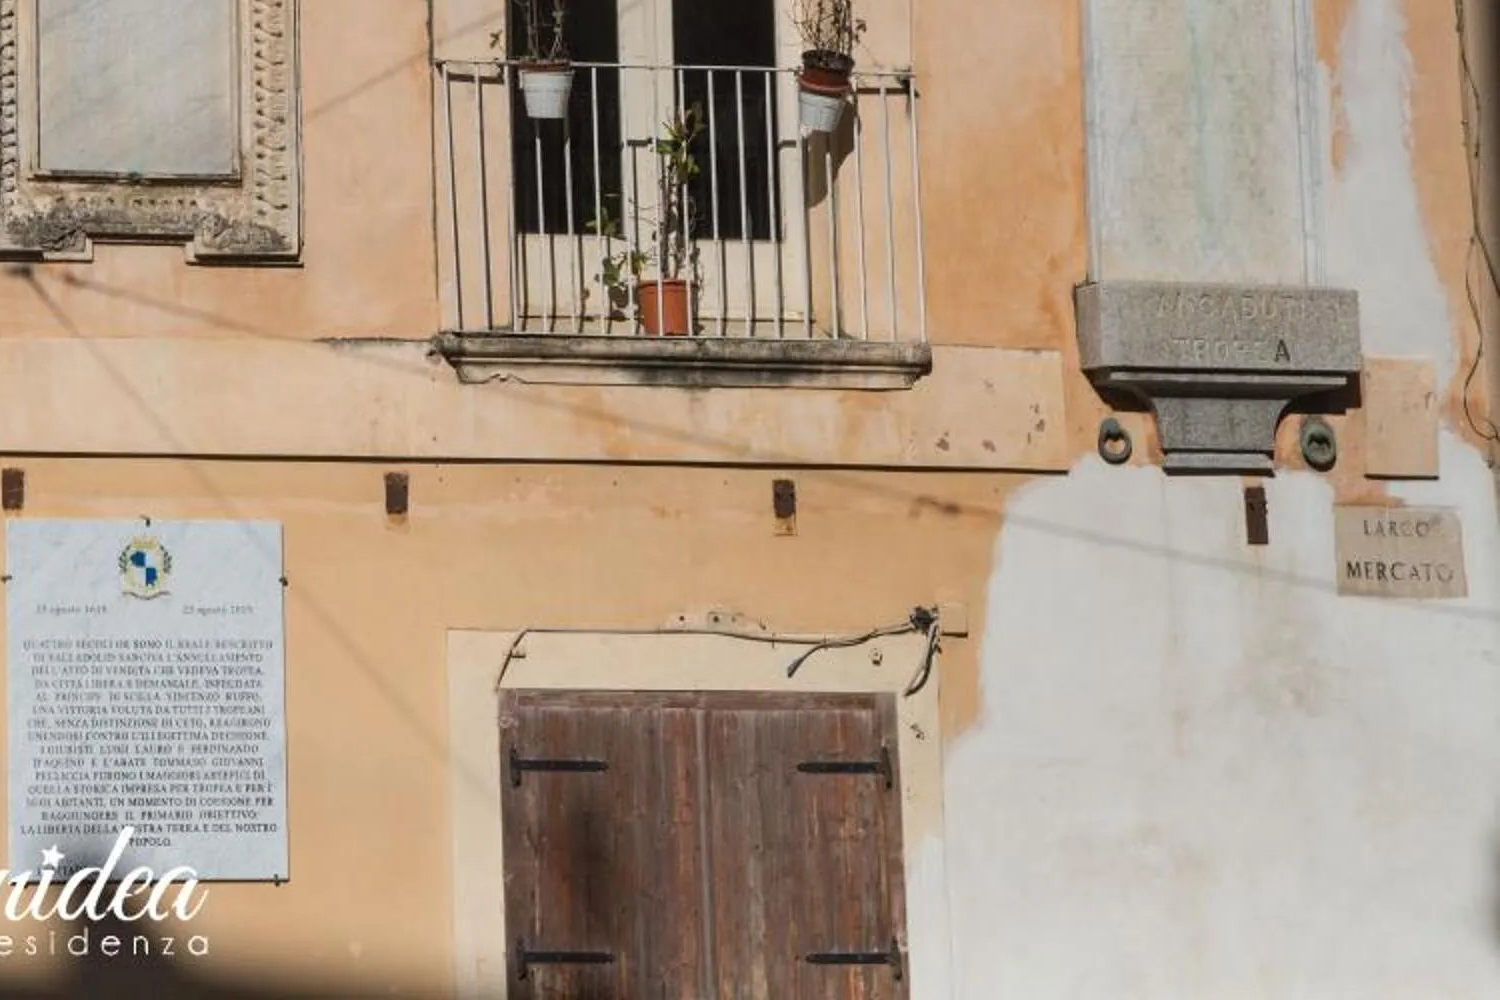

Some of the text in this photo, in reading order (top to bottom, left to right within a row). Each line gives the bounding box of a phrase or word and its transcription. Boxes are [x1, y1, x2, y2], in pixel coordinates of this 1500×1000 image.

[1346, 560, 1454, 582] MERCATO
[132, 639, 163, 650] SONO
[47, 652, 116, 663] VALLADOLID
[105, 665, 152, 676] VENDITA
[154, 665, 175, 676] CHE
[177, 665, 220, 676] VEDEVA
[167, 691, 220, 702] VINCENZO
[57, 705, 108, 715] VITTORIA
[110, 705, 153, 715] VOLUTA
[55, 718, 89, 729] SENZA
[90, 718, 159, 729] DISTINZIONE
[85, 731, 129, 741] CONTRO
[135, 744, 173, 754] LAURO
[191, 744, 260, 754] FERDINANDO
[103, 757, 147, 769] L'ABATE
[153, 757, 207, 769] TOMMASO
[92, 771, 138, 781] FURONO
[73, 783, 119, 795] STORICA
[120, 783, 167, 795] IMPRESA
[169, 783, 189, 795] PER
[244, 783, 265, 795] PER
[109, 797, 126, 807] UN
[128, 797, 183, 807] MOMENTO
[184, 797, 198, 807] DI
[254, 797, 274, 807] PER
[124, 810, 136, 821] IL
[140, 810, 193, 821] PRIMARIO
[82, 823, 118, 835] DELLA
[120, 823, 164, 835] STRA
[166, 823, 201, 835] TERRA
[235, 823, 278, 835] NOSTRO
